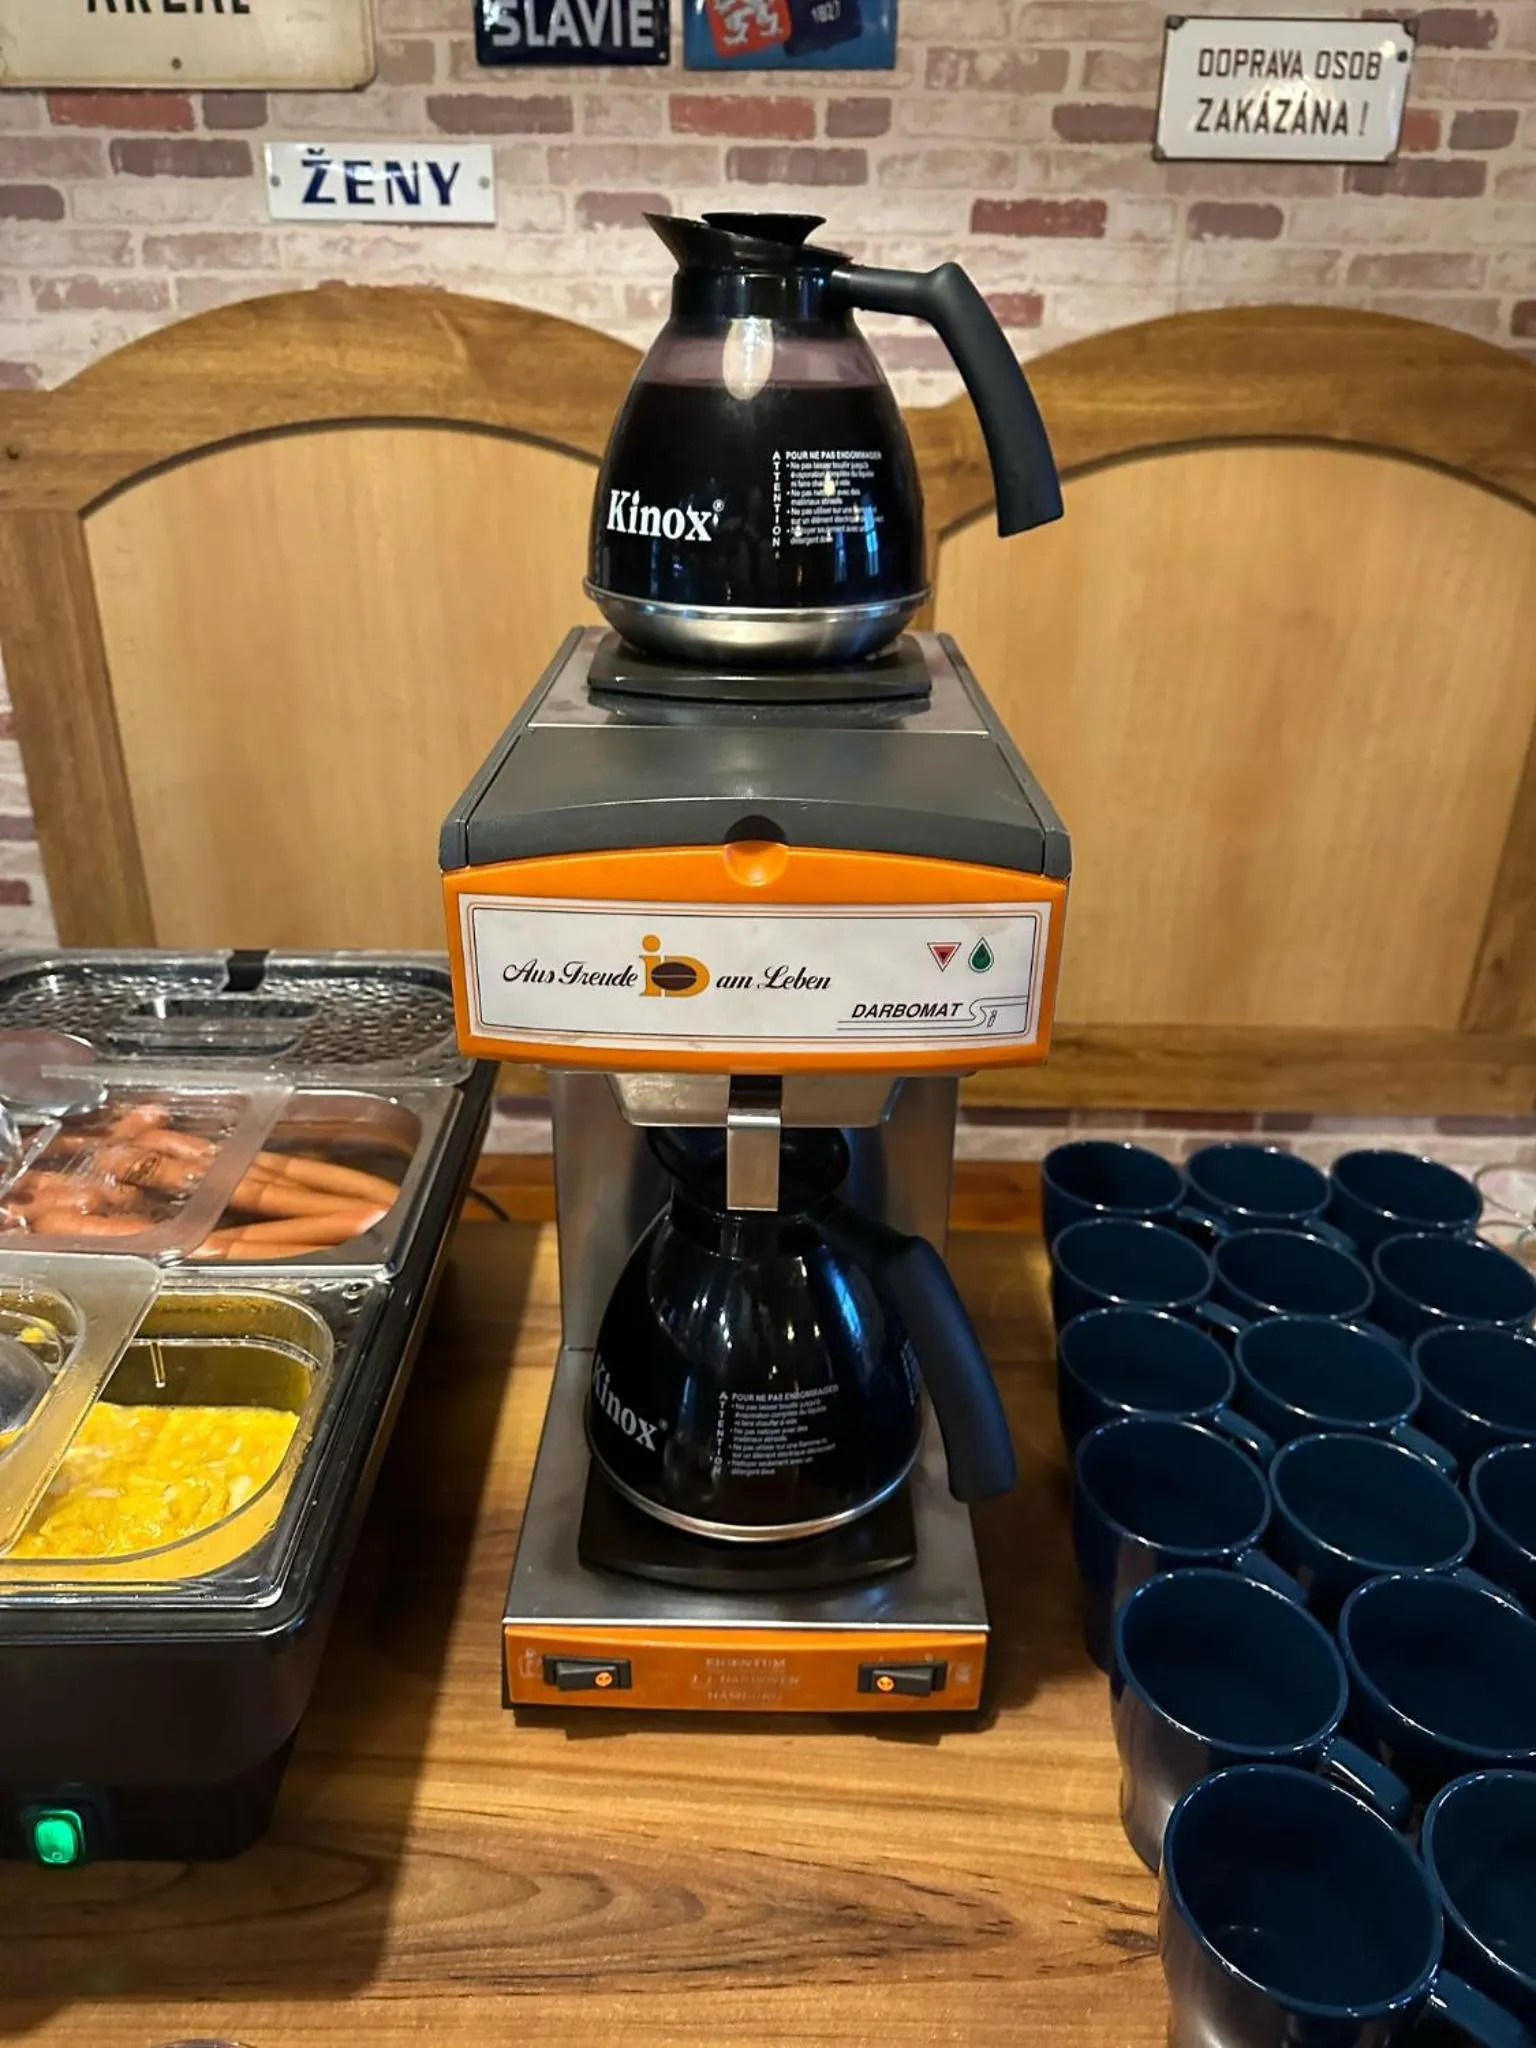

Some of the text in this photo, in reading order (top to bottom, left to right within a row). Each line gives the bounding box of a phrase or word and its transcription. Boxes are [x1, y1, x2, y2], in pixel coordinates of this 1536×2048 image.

[490, 0, 655, 48] SLAVIE
[1197, 47, 1382, 80] DOPRAVA OSOB
[300, 147, 461, 206] ŽENY
[772, 450, 782, 547] ATTENTION
[502, 958, 555, 984] Aus
[716, 974, 753, 990] am
[757, 965, 832, 990] Leben
[851, 1002, 964, 1019] DARBOMAT
